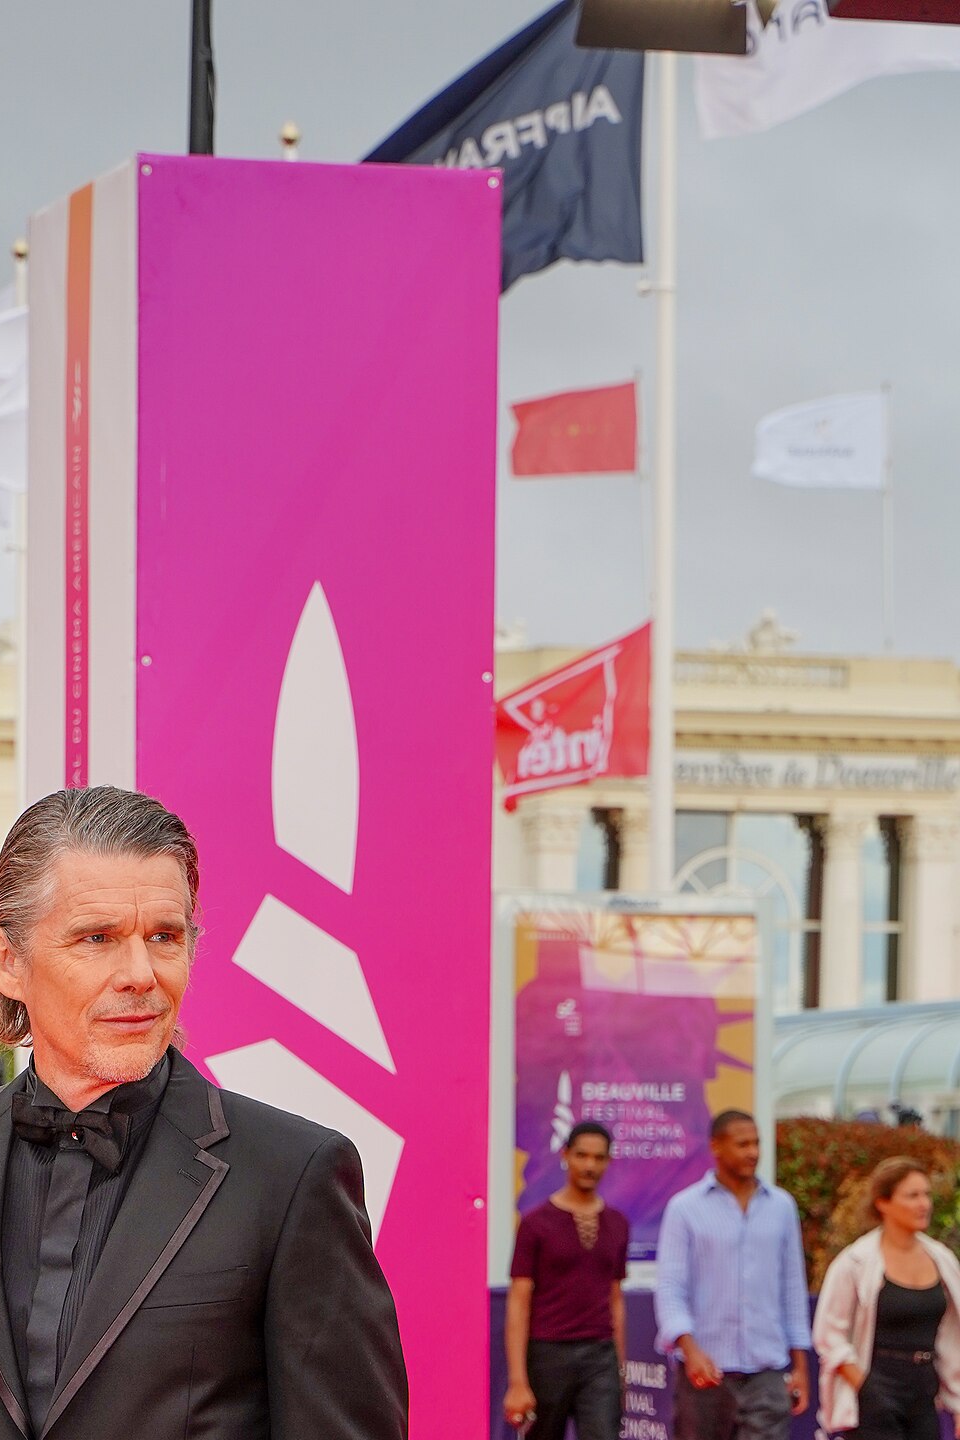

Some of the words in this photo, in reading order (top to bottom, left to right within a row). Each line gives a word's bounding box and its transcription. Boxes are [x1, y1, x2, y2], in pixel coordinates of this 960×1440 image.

[581, 1082, 686, 1102] DEAUVILLE
[581, 1103, 668, 1122] FESTIVAL
[611, 1122, 686, 1140] CINEMA
[609, 1141, 686, 1160] ERICAIN
[624, 1390, 657, 1417] IVAL
